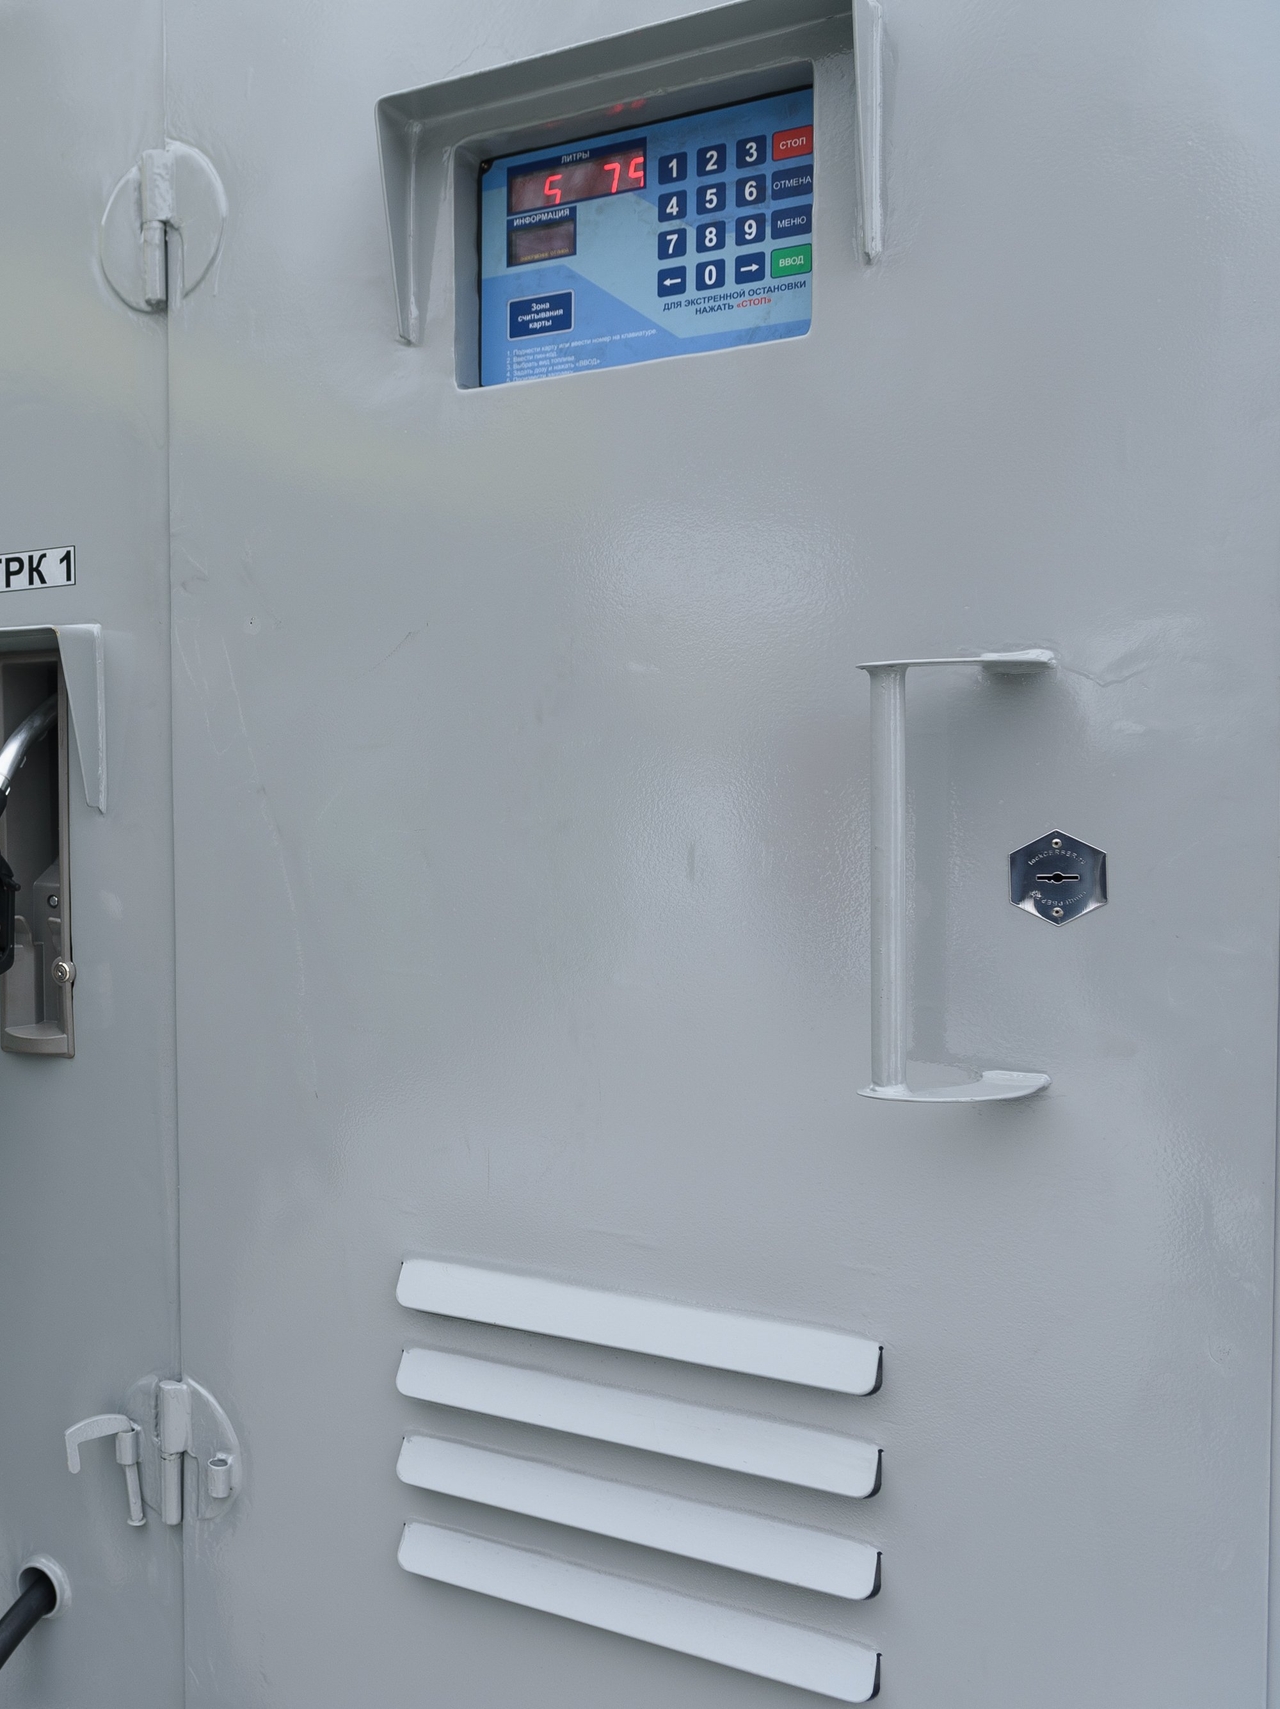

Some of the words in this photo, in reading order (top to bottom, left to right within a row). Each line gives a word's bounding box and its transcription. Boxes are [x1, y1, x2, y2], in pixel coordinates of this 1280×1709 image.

[745, 141, 758, 163] 3
[779, 136, 806, 150] СТОП
[561, 150, 590, 164] ЛИТРЫ
[705, 150, 718, 172] 2
[668, 158, 677, 178] 1
[744, 180, 757, 201] 6
[773, 175, 812, 191] ОТМЕНА
[666, 196, 679, 216] 4
[705, 188, 718, 209] 5
[513, 208, 570, 227] ИНФОРМАЦИЯ
[777, 215, 807, 229] МЕНЮ
[704, 226, 717, 247] 8
[744, 219, 757, 240] 9
[666, 233, 679, 254] 7
[779, 255, 804, 268] ВВОД
[704, 264, 717, 285] 0
[663, 300, 682, 312] ДЛЯ
[685, 288, 746, 308] ЭКСТРЕННОЙ
[748, 280, 806, 297] ОСТАНОВКИ
[695, 303, 734, 315] НАЖАТЬ
[736, 296, 772, 310] «СТОП»
[518, 308, 564, 322] считывания
[531, 302, 550, 311] Зона
[529, 319, 552, 329] карты
[59, 550, 71, 582] 1
